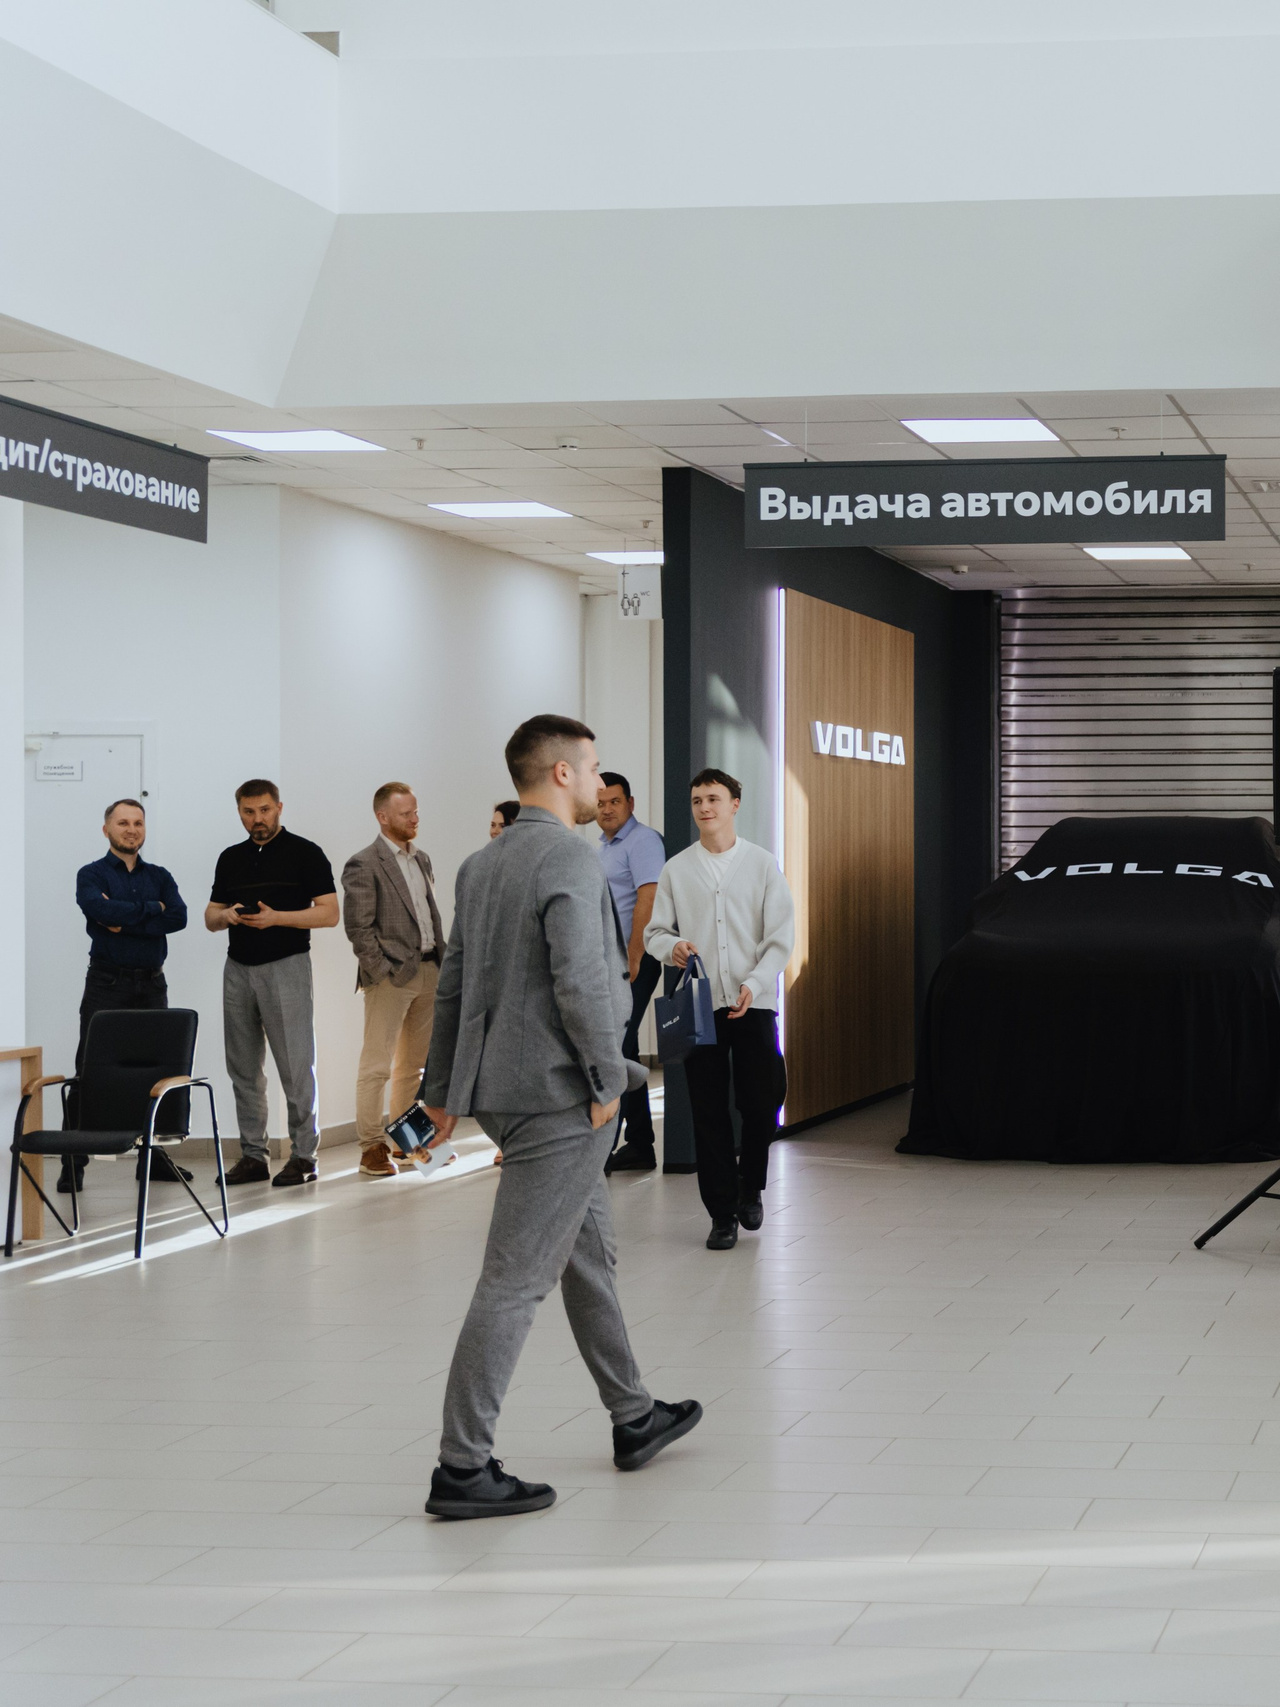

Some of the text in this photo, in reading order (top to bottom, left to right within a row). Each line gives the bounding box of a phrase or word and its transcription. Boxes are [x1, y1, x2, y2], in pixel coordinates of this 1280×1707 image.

[759, 480, 1213, 526] Выдача автомобиля
[814, 720, 906, 766] VOLGA
[1013, 862, 1275, 888] VOLGA
